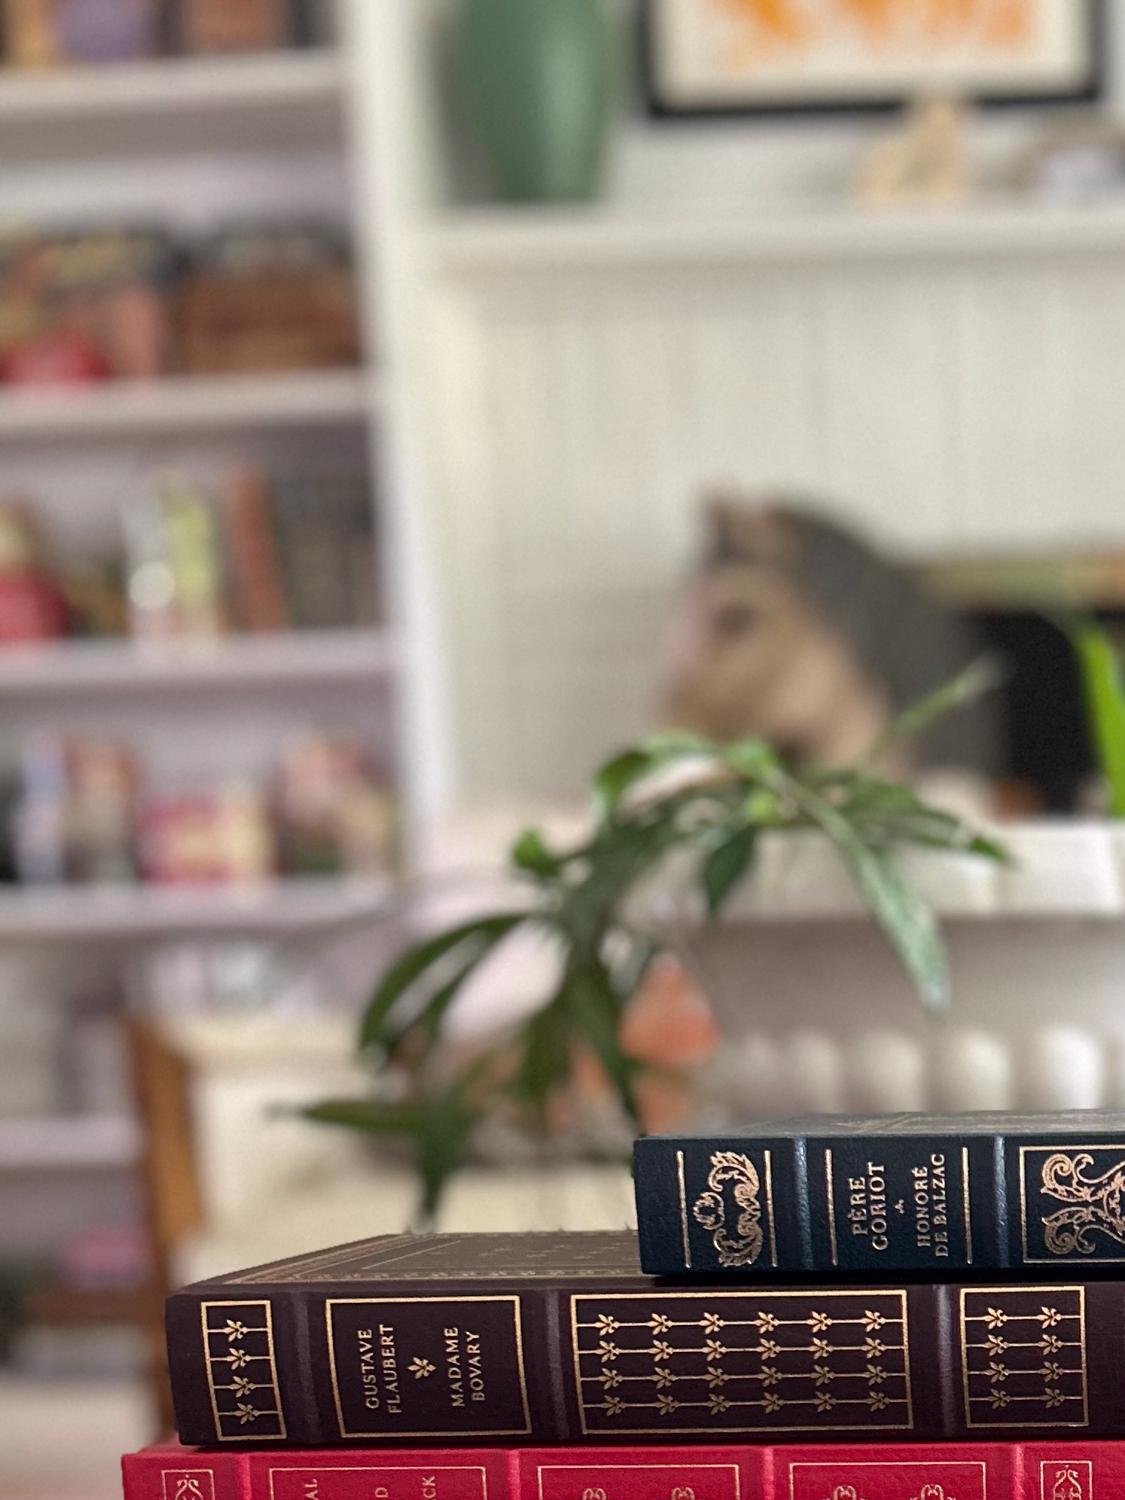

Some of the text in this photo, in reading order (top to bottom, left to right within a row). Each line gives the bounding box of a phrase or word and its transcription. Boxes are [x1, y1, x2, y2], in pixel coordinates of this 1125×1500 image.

[848, 1177, 869, 1236] PÈRE
[868, 1162, 889, 1251] GORIOT
[911, 1166, 931, 1247] HONORÉ
[930, 1153, 949, 1257] DE BALZAC
[358, 1328, 380, 1409] GUSTAVE
[379, 1324, 402, 1414] FLAUBERT
[444, 1327, 465, 1407] MADAME
[465, 1331, 485, 1401] BOVARY
